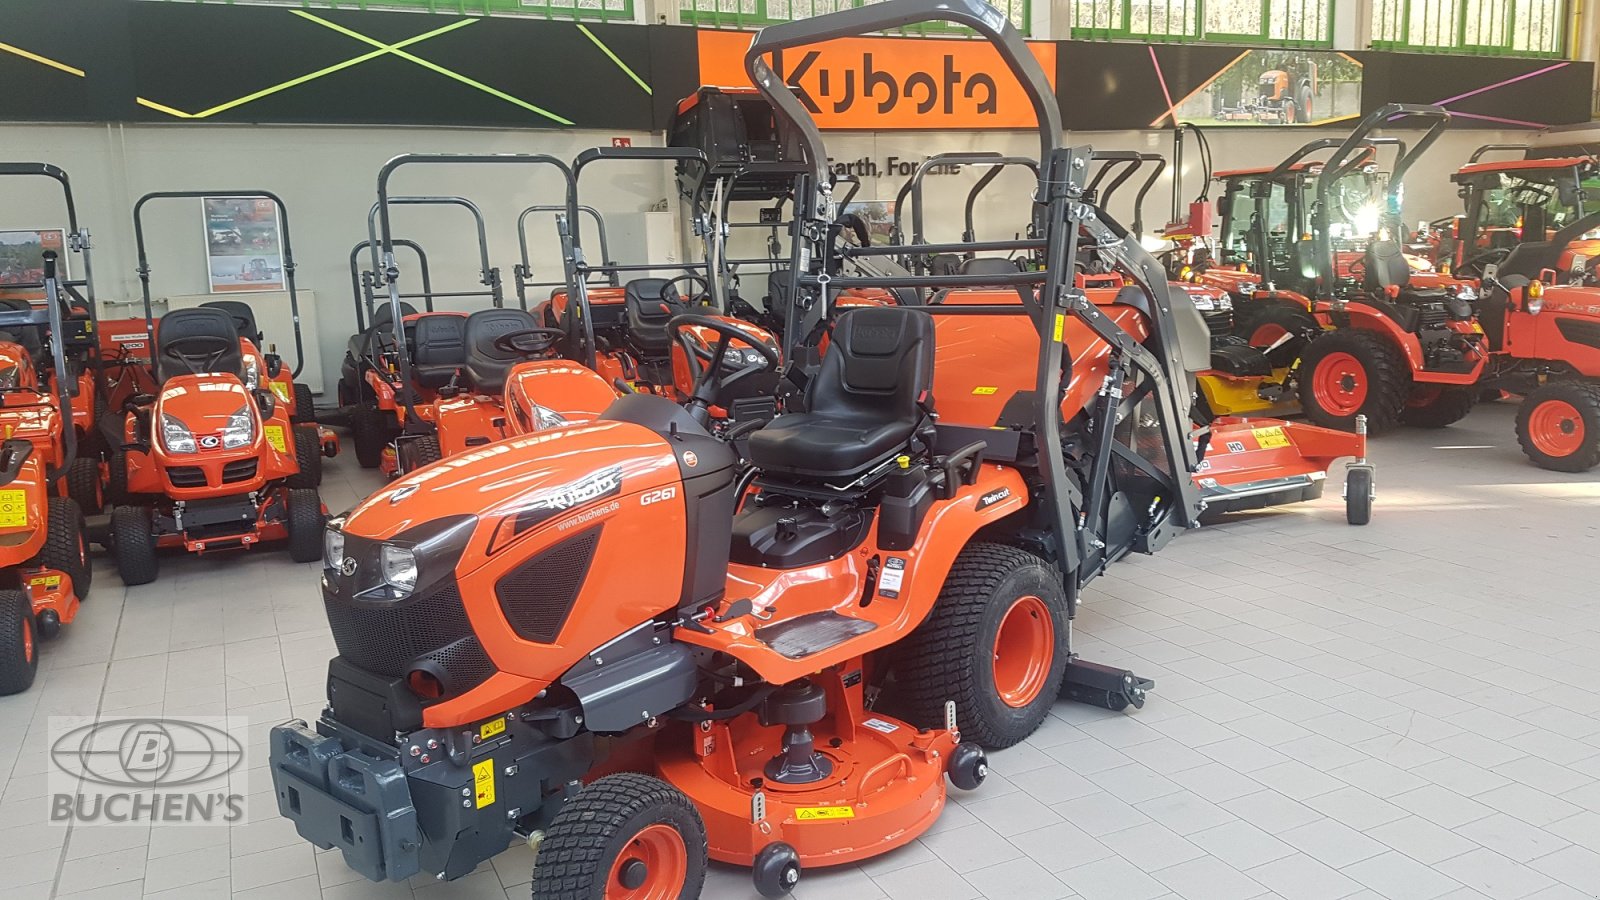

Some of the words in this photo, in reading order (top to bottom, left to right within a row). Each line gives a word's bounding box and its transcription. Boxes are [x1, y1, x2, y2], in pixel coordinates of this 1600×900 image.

[772, 50, 997, 114] Kubota
[887, 157, 919, 176] For
[1228, 442, 1243, 451] HD
[545, 473, 620, 509] Kubota
[640, 486, 676, 506] G261
[556, 501, 620, 532] www.buchens.de
